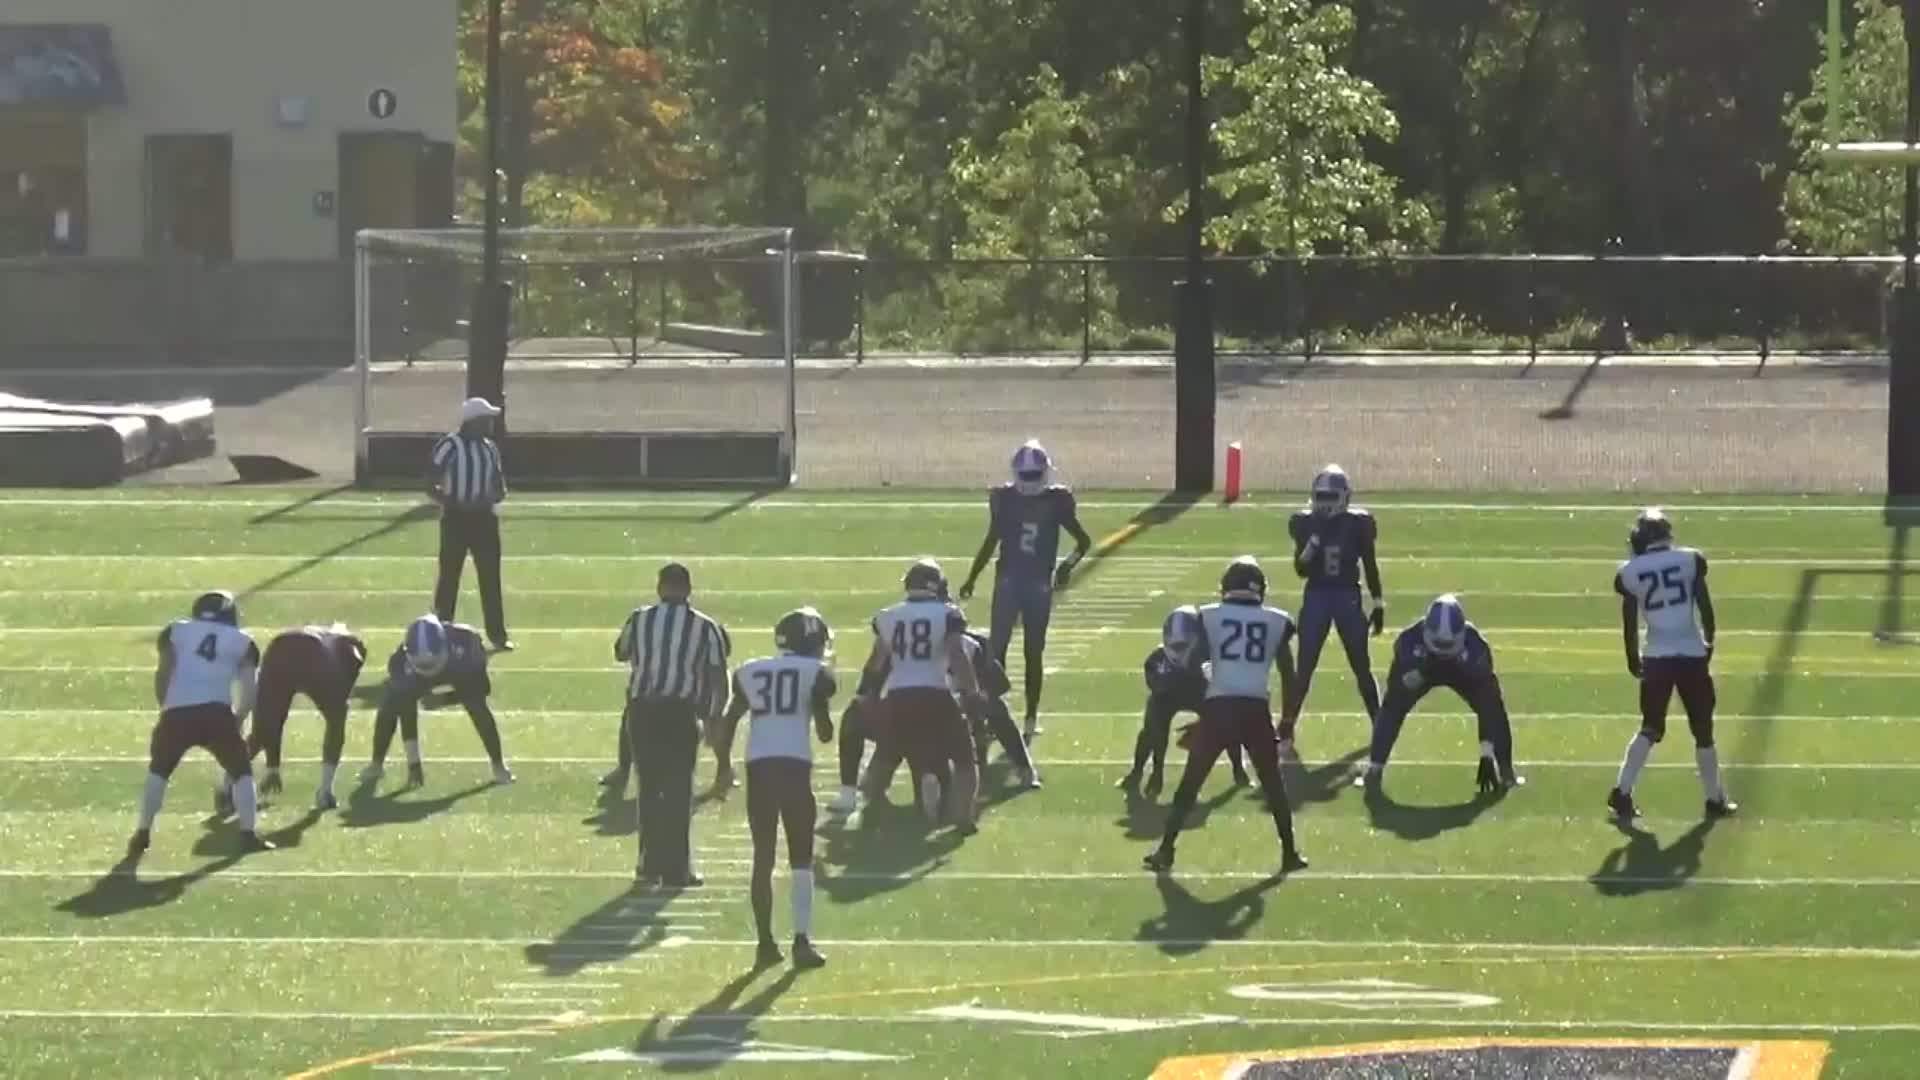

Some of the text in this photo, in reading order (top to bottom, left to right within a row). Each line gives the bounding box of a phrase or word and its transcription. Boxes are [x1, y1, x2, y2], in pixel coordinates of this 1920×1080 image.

[1018, 523, 1039, 554] 2
[1638, 566, 1689, 611] 25
[195, 633, 218, 662] 4
[890, 618, 932, 661] 48
[1219, 620, 1268, 663] 28
[750, 669, 800, 716] 30
